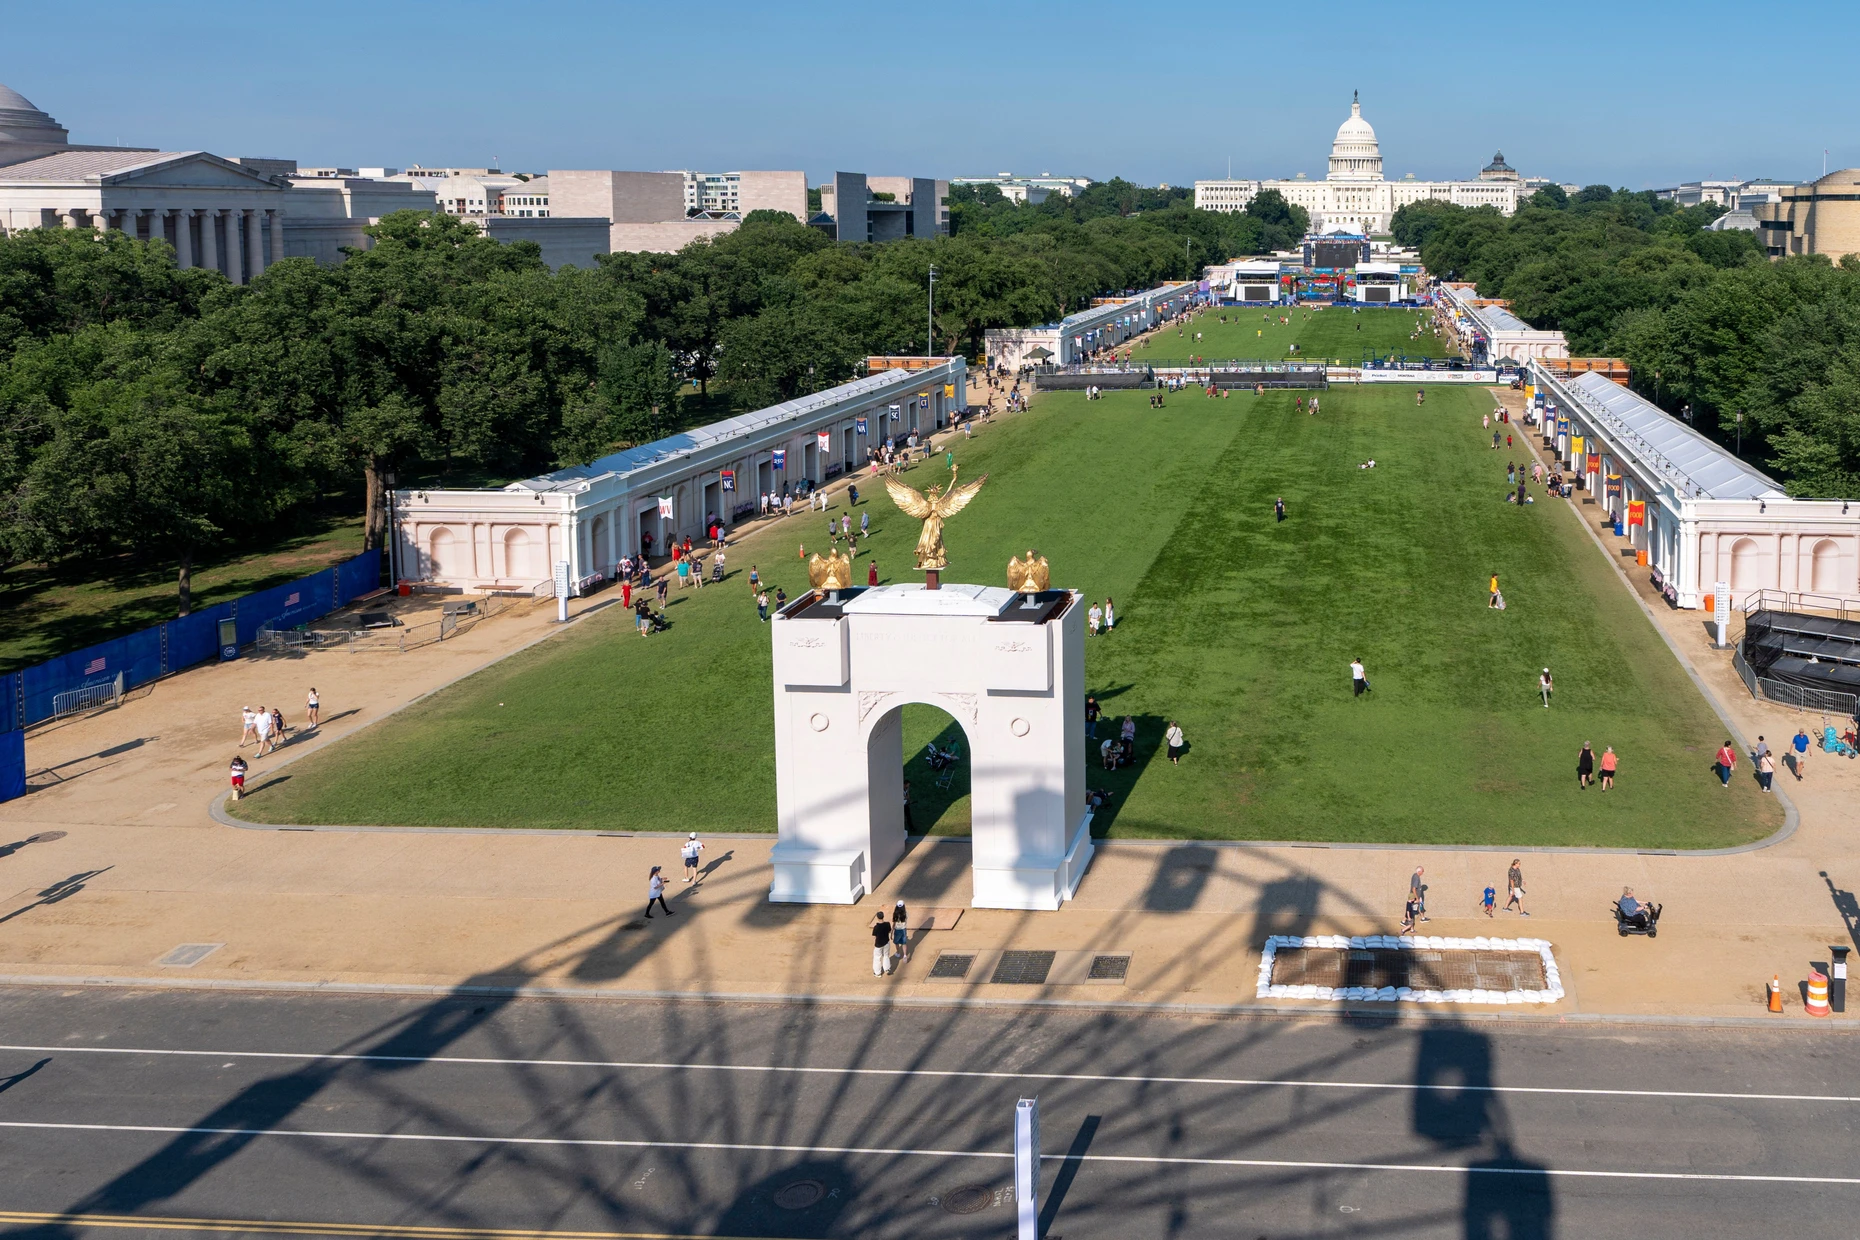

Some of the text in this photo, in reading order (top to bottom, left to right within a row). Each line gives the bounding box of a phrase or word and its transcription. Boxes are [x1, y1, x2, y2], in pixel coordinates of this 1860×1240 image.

[921, 399, 928, 407] CT
[891, 411, 899, 419] SC
[857, 425, 866, 433] VA
[724, 480, 734, 489] NC
[660, 505, 671, 514] WV
